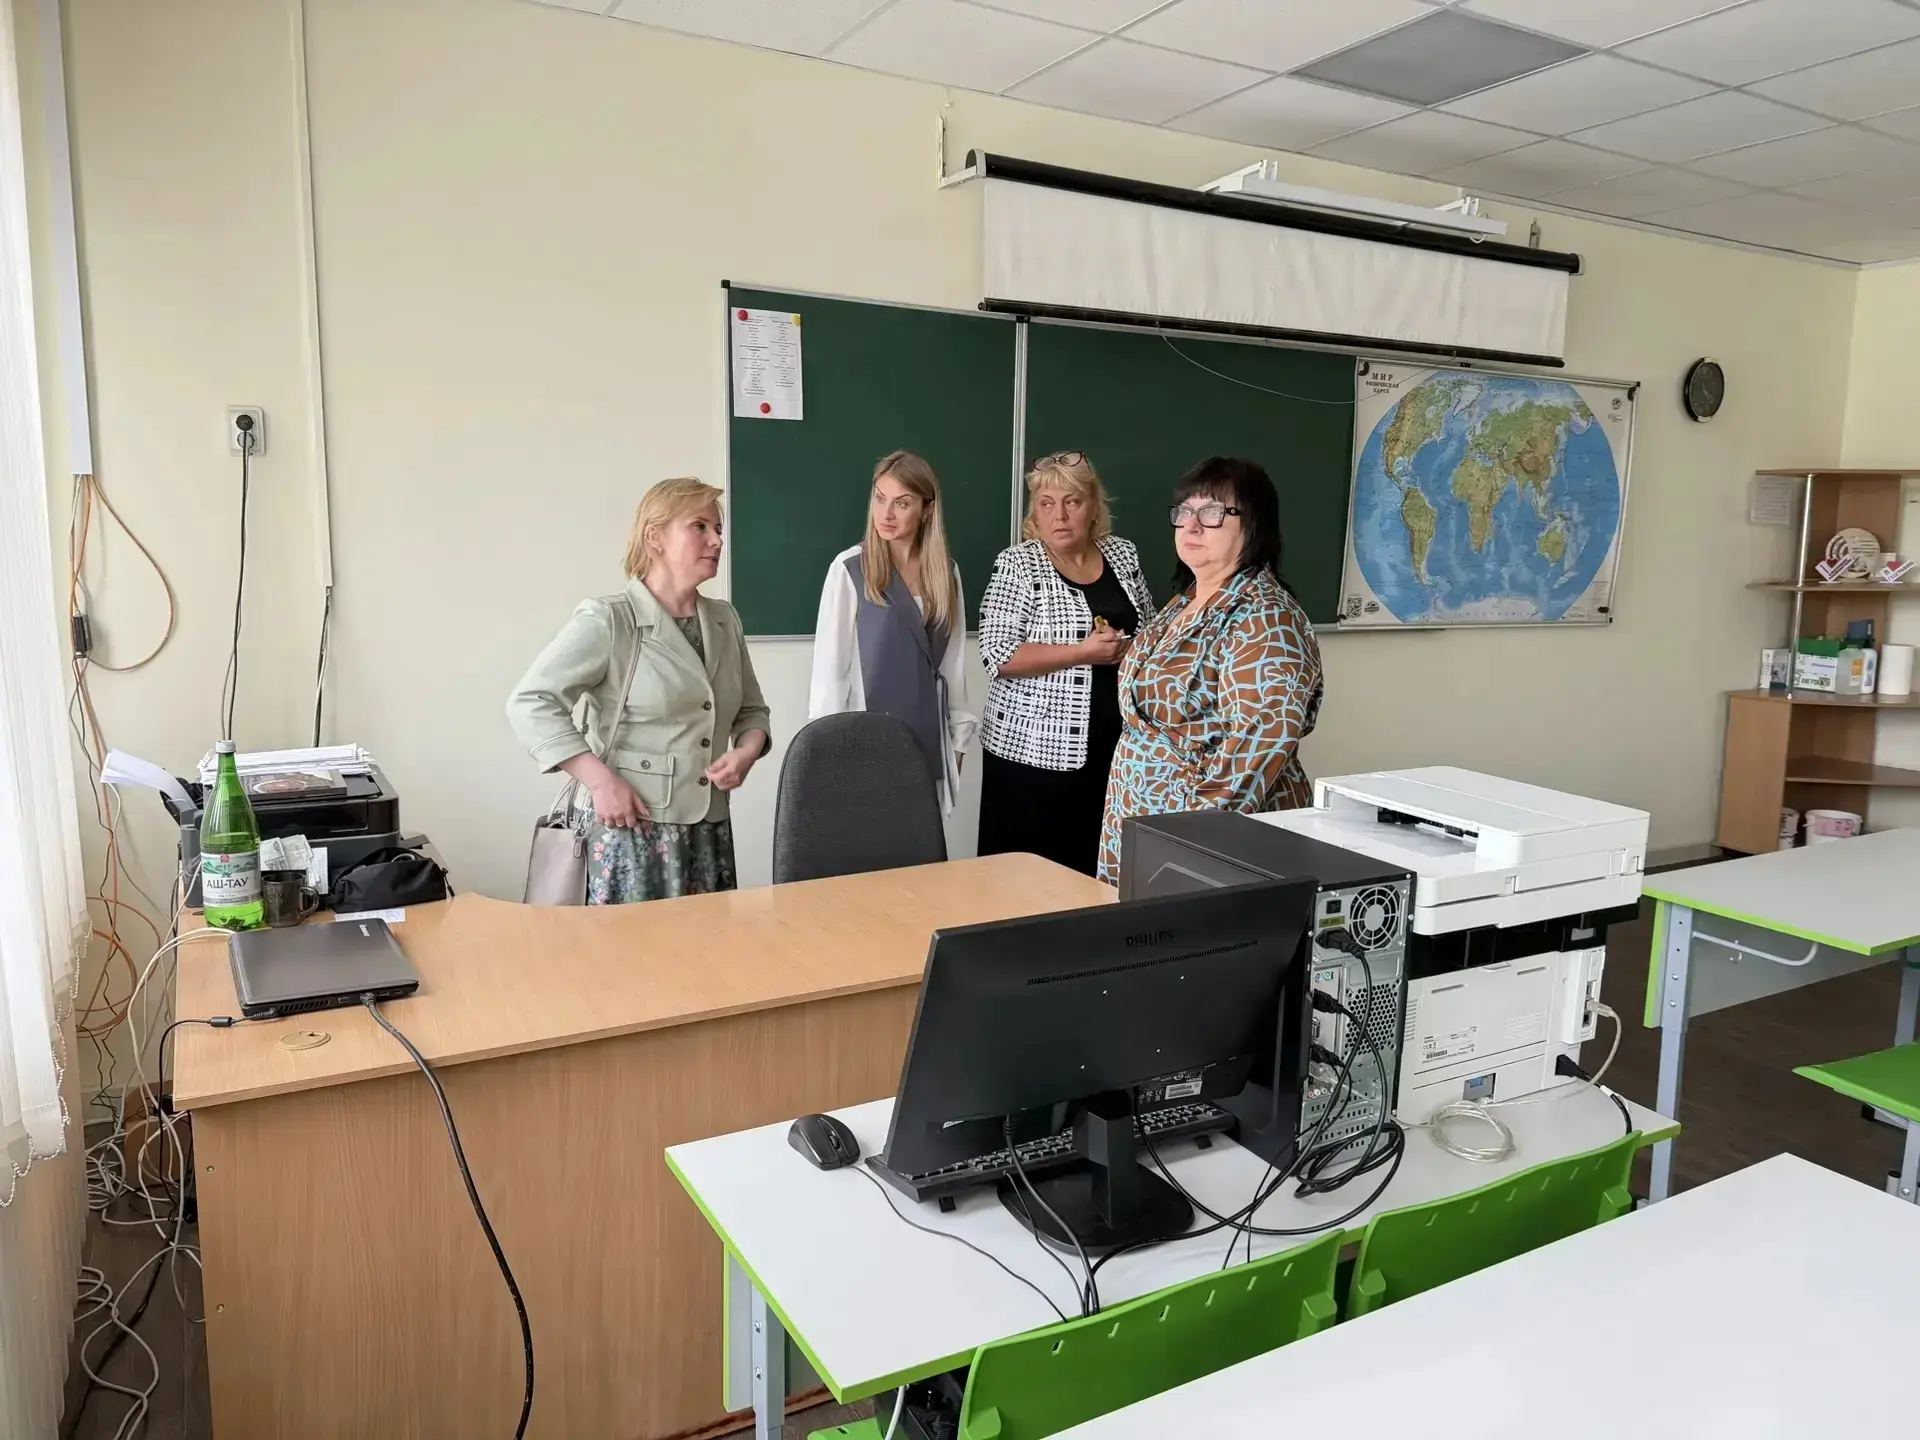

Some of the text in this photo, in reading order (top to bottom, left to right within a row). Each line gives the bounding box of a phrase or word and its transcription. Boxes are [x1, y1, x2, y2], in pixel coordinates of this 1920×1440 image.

[1371, 372, 1394, 381] МИР
[1365, 381, 1400, 389] ФИЗИЧЕСКАЯ
[206, 876, 249, 889] АШ-ТАУ
[1126, 929, 1174, 948] PHILIPS
